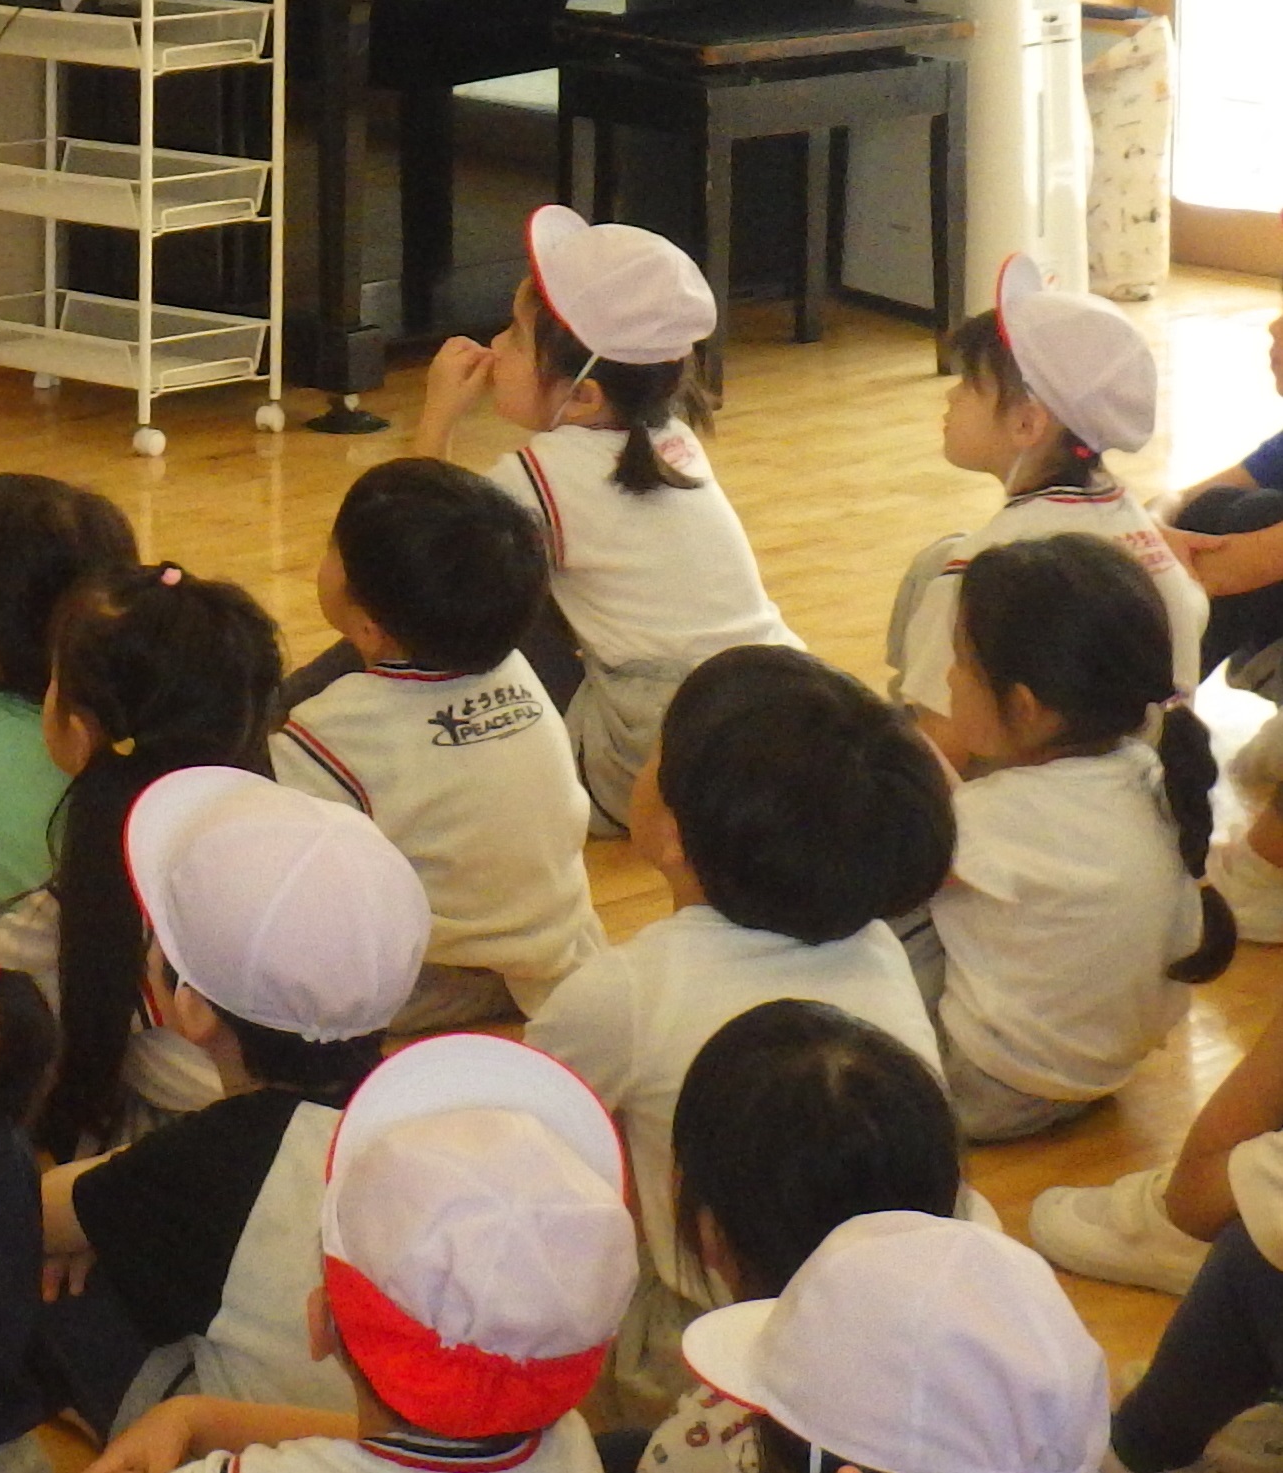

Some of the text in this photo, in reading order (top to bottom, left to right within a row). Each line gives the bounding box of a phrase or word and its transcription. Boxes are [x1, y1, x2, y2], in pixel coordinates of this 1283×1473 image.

[461, 683, 532, 716] ようちえん
[460, 706, 539, 741] PEACEFUL
